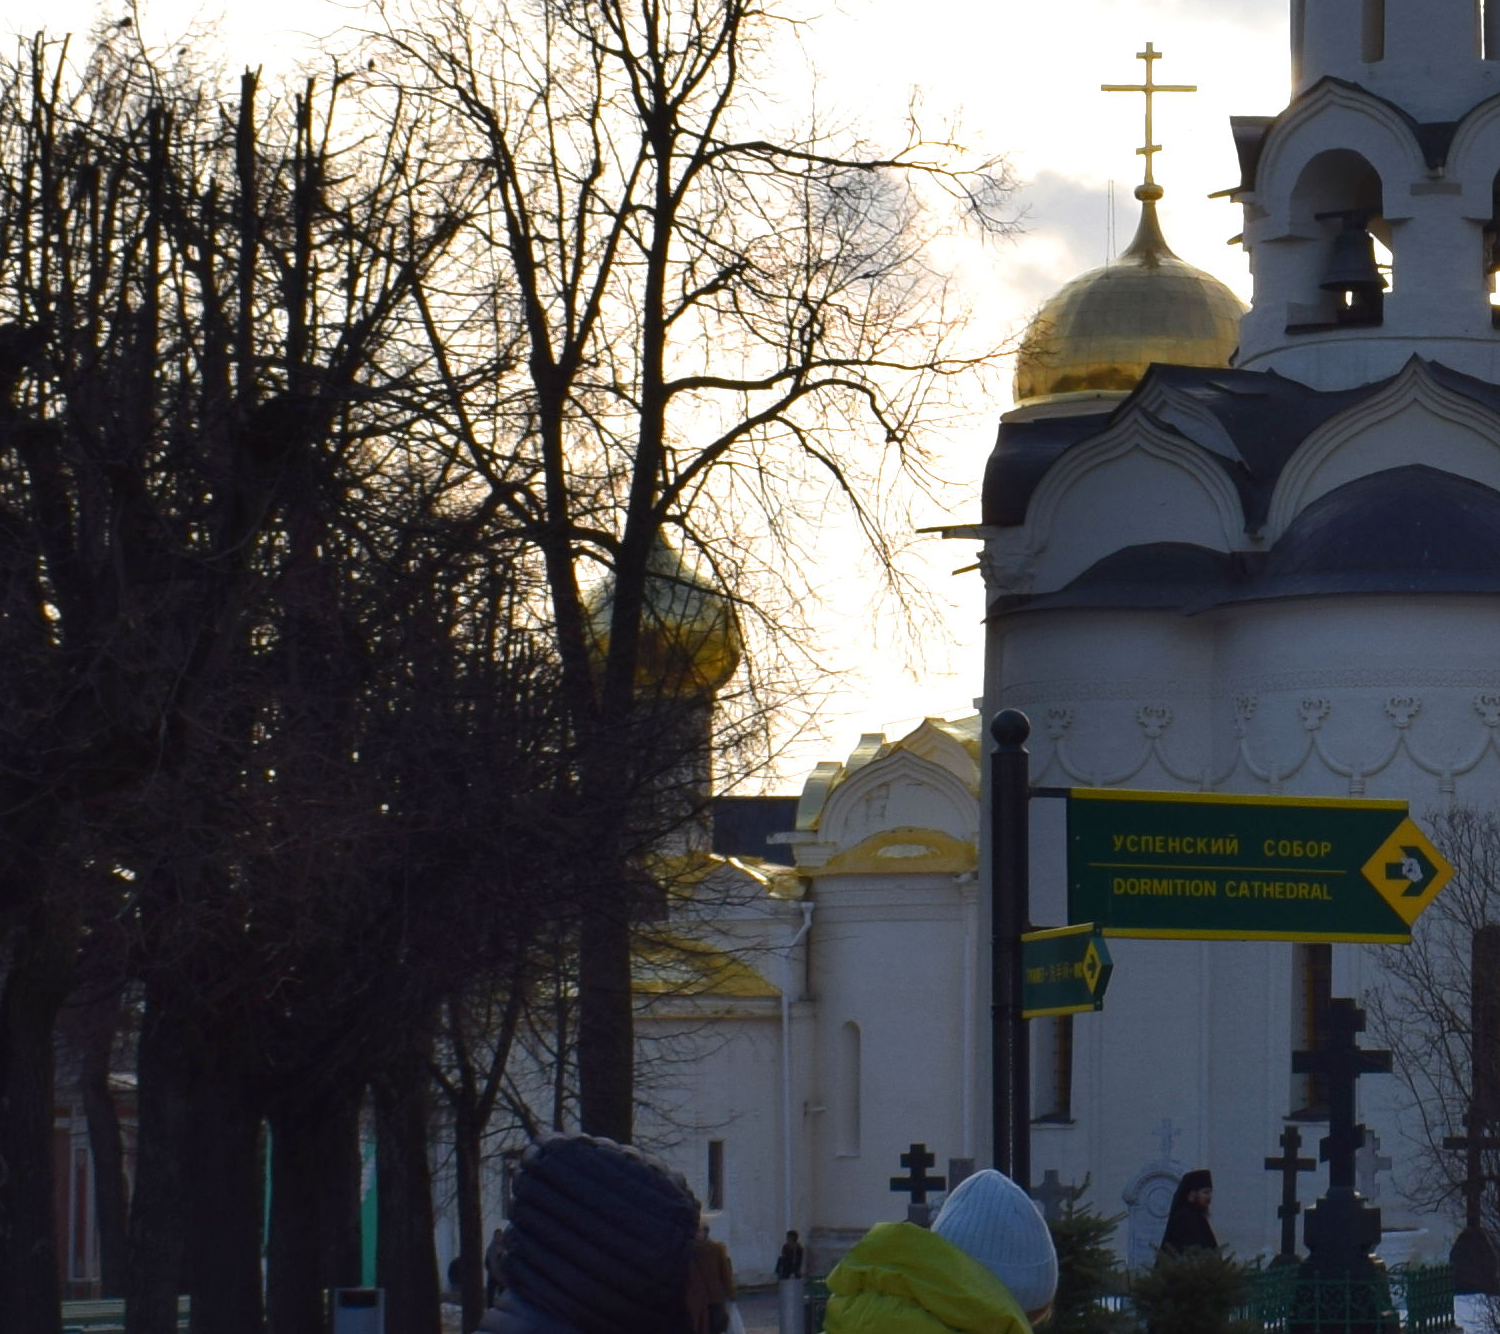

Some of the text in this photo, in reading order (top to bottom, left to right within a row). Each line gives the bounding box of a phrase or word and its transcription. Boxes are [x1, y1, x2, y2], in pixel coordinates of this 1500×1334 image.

[1112, 834, 1332, 858] УСПЕНСКИЙ СОБОР
[1112, 878, 1333, 900] DORMITION CATHEDRAL
